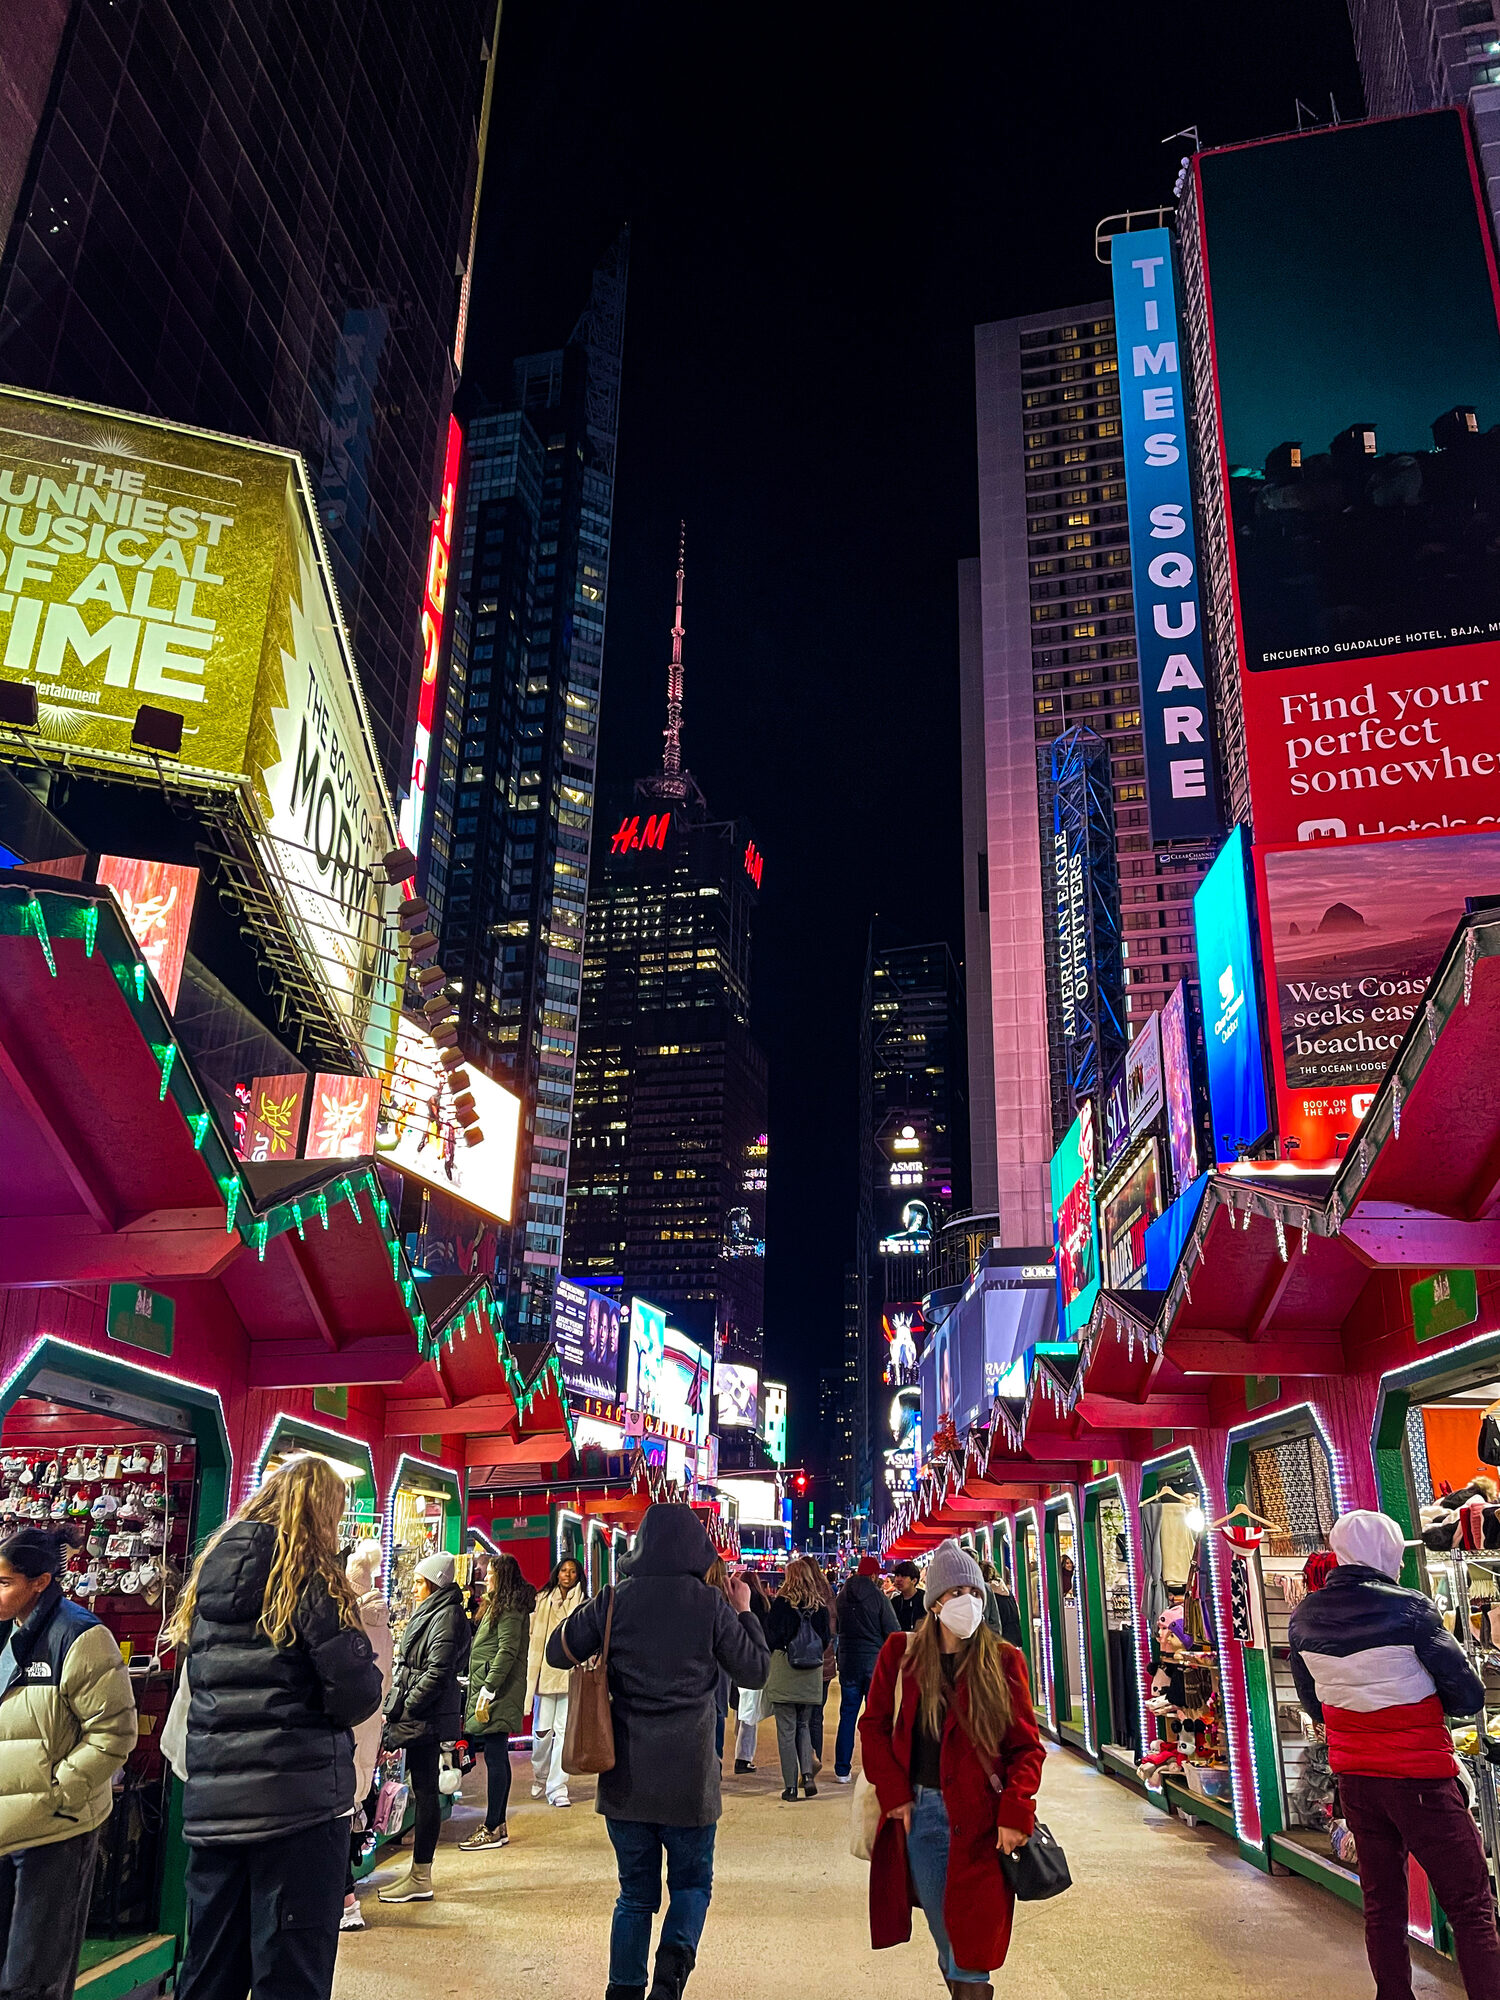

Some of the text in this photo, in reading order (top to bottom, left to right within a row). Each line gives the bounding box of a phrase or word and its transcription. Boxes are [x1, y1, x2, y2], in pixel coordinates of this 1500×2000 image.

[1131, 256, 1180, 467] TIMES
[0, 546, 217, 632] F ALL
[1147, 503, 1207, 799] SQUARE
[1262, 645, 1330, 662] ENCUENTRO
[1334, 635, 1402, 653] GUADALUPE
[1451, 625, 1484, 637] BAJA,
[1488, 622, 1500, 631] M
[22, 677, 102, 705] Entertainment
[1280, 678, 1490, 725] Find your
[307, 662, 374, 853] THE BOOK OF
[1285, 717, 1442, 769] perfect
[610, 811, 671, 854] H&M
[1054, 830, 1076, 1037] AMERICAN EAGLE
[1068, 853, 1089, 1000] OUTFITTERS
[1285, 979, 1352, 1003] West
[1294, 1003, 1365, 1028] seeks
[1299, 1060, 1387, 1075] THE OCEAN LODGE
[1303, 1098, 1347, 1110] BOOK ON
[1303, 1105, 1347, 1117] THE APP
[1022, 1265, 1057, 1278] GIORGI
[585, 1397, 622, 1422] 1540
